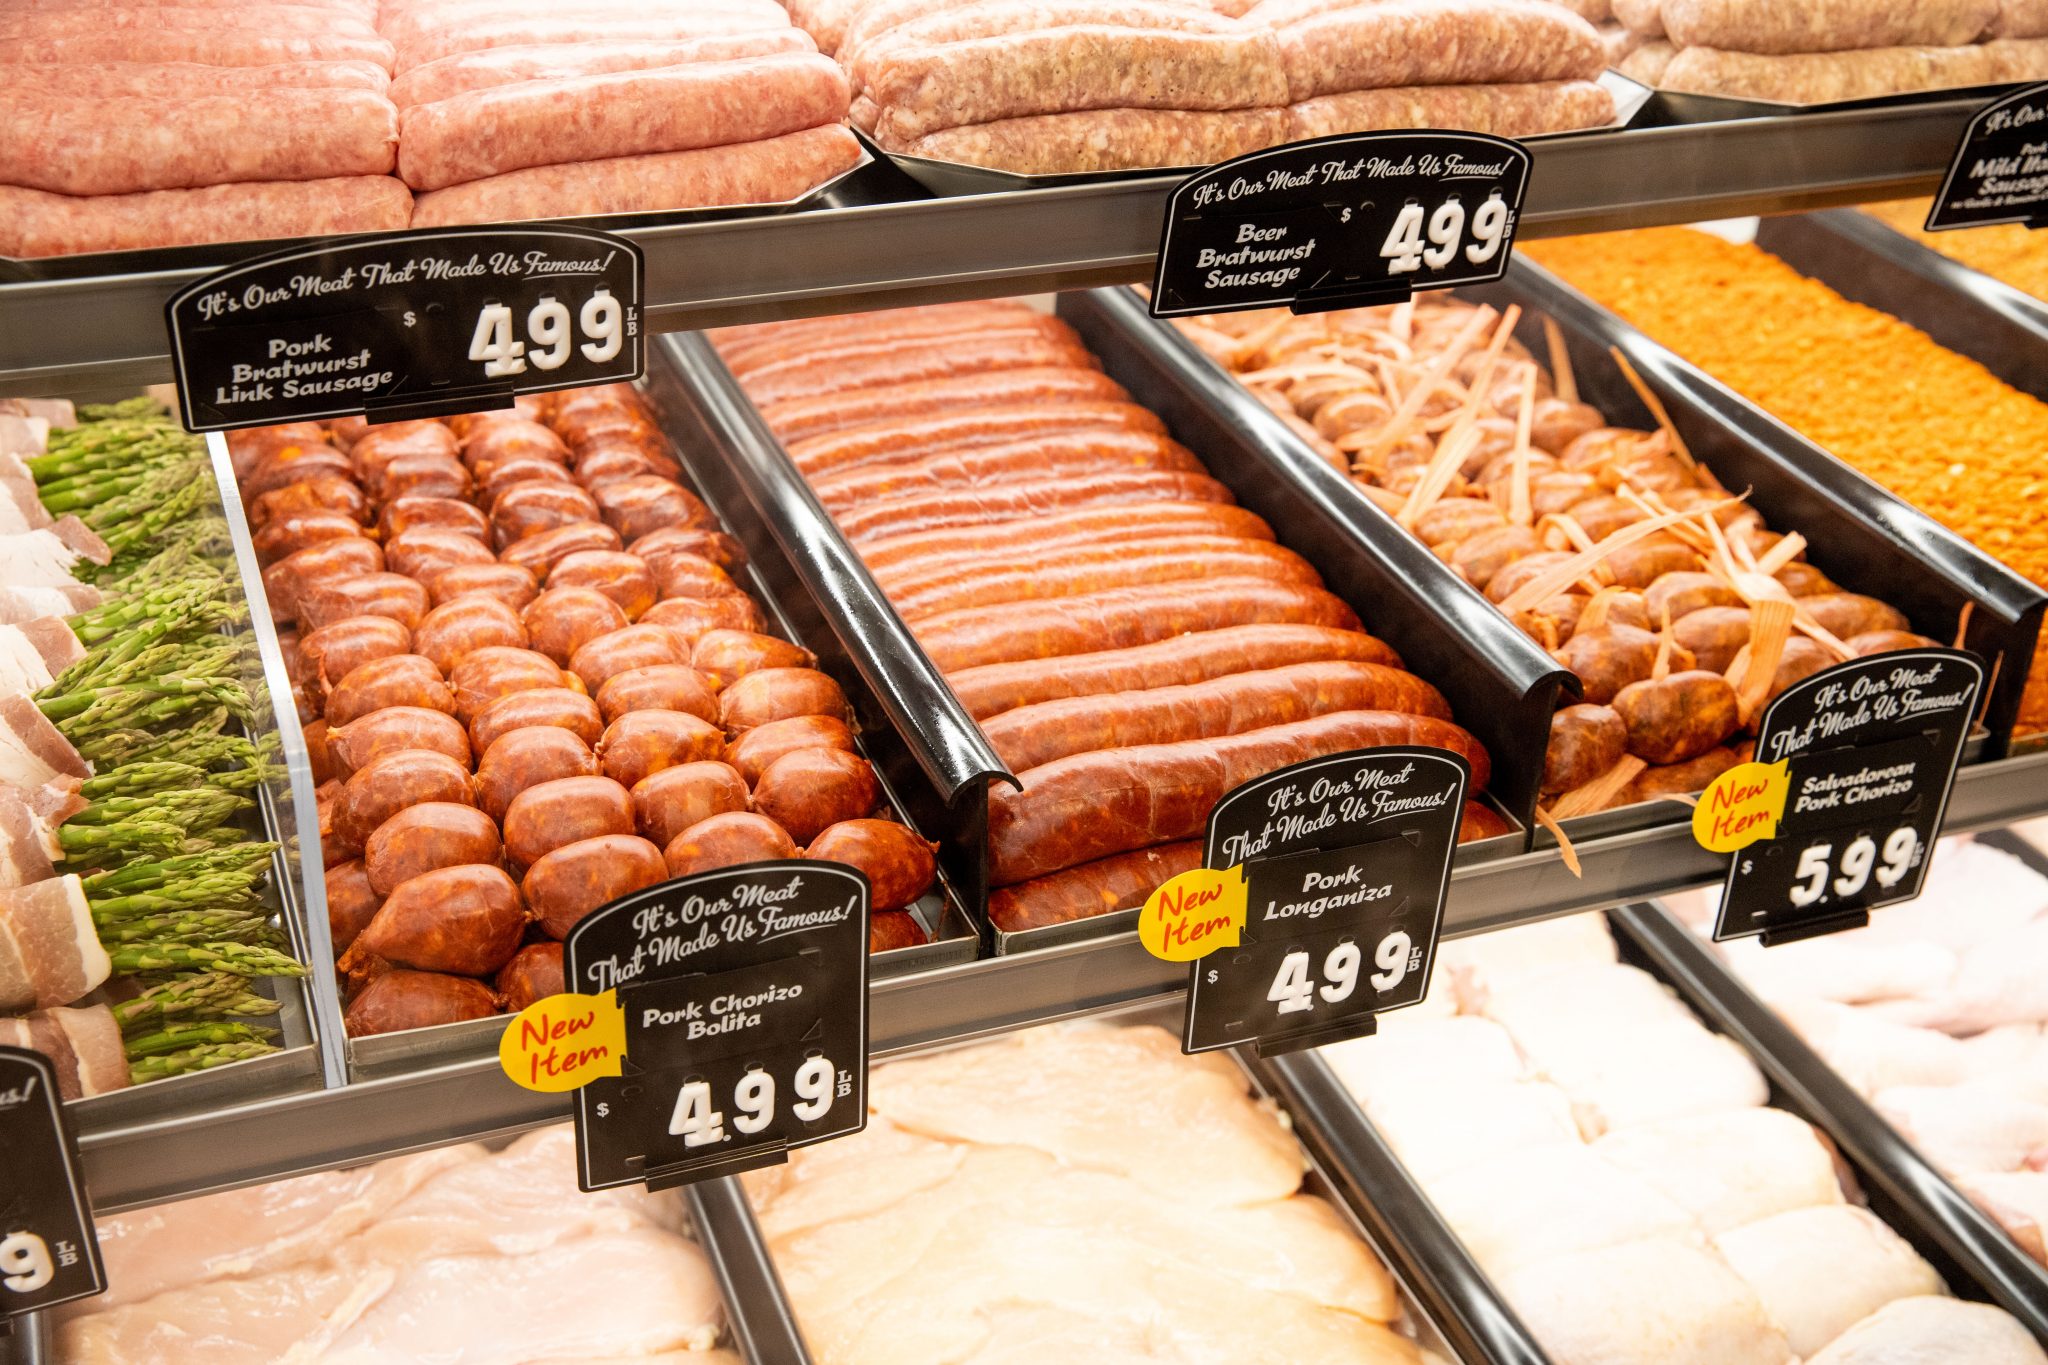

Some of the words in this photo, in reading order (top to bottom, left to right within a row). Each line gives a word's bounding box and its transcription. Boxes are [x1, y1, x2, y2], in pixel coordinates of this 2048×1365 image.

[1194, 182, 1225, 209] It's
[1228, 176, 1266, 201] Our
[1266, 164, 1318, 191] Meat
[1322, 160, 1366, 185] That
[1366, 156, 1415, 177] Made
[1418, 154, 1442, 175] Us
[1442, 153, 1515, 178] Famous!
[1968, 156, 2022, 179] Mild
[1340, 206, 1352, 223] $
[1235, 223, 1288, 244] Beer
[1196, 239, 1316, 268] Bratwurst
[197, 290, 241, 321] It's
[243, 284, 291, 310] Our
[290, 267, 357, 297] Meat
[360, 259, 419, 289] That
[420, 253, 486, 280] Made
[488, 252, 521, 275] Us
[522, 250, 617, 278] Famous!
[1204, 266, 1301, 289] Sausage
[403, 310, 417, 328] $
[268, 333, 332, 360] Pork
[232, 348, 371, 384] Bratwurst
[215, 380, 273, 405] Link
[282, 369, 393, 399] Sausage
[1814, 682, 1848, 714] It's
[1849, 675, 1888, 703] Our
[1889, 662, 1943, 689] Meat
[1770, 721, 1818, 763] That
[1818, 701, 1873, 739] Made
[1874, 694, 1900, 720] Us
[1899, 682, 1975, 718] Famous!
[1267, 785, 1306, 817] It's
[1309, 777, 1353, 804] Our
[1354, 762, 1416, 792] Meat
[1711, 778, 1769, 814] New
[1794, 793, 1841, 813] Pork
[1844, 779, 1913, 804] Chorizo
[1801, 762, 1917, 795] Salvadorean
[1222, 826, 1276, 869] That
[1276, 805, 1337, 843] Made
[1339, 796, 1370, 823] Us
[1369, 782, 1457, 820] Famous!
[1711, 809, 1770, 845] Item
[1302, 864, 1364, 893] Pork
[1741, 860, 1753, 876] $
[632, 903, 678, 940] It's
[681, 894, 733, 924] Our
[732, 876, 804, 911] Meat
[1157, 883, 1223, 922] New
[1263, 882, 1394, 922] Longaniza
[587, 950, 647, 994] That
[648, 926, 719, 967] Made
[721, 915, 757, 942] Us
[757, 895, 858, 937] Famous!
[1162, 915, 1231, 953] Item
[1207, 969, 1219, 985] $
[643, 1003, 704, 1028] Pork
[709, 984, 804, 1016] Chorizo
[521, 1010, 595, 1052] New
[686, 1011, 762, 1041] Bolita
[531, 1044, 608, 1085] Item
[596, 1102, 610, 1118] $
